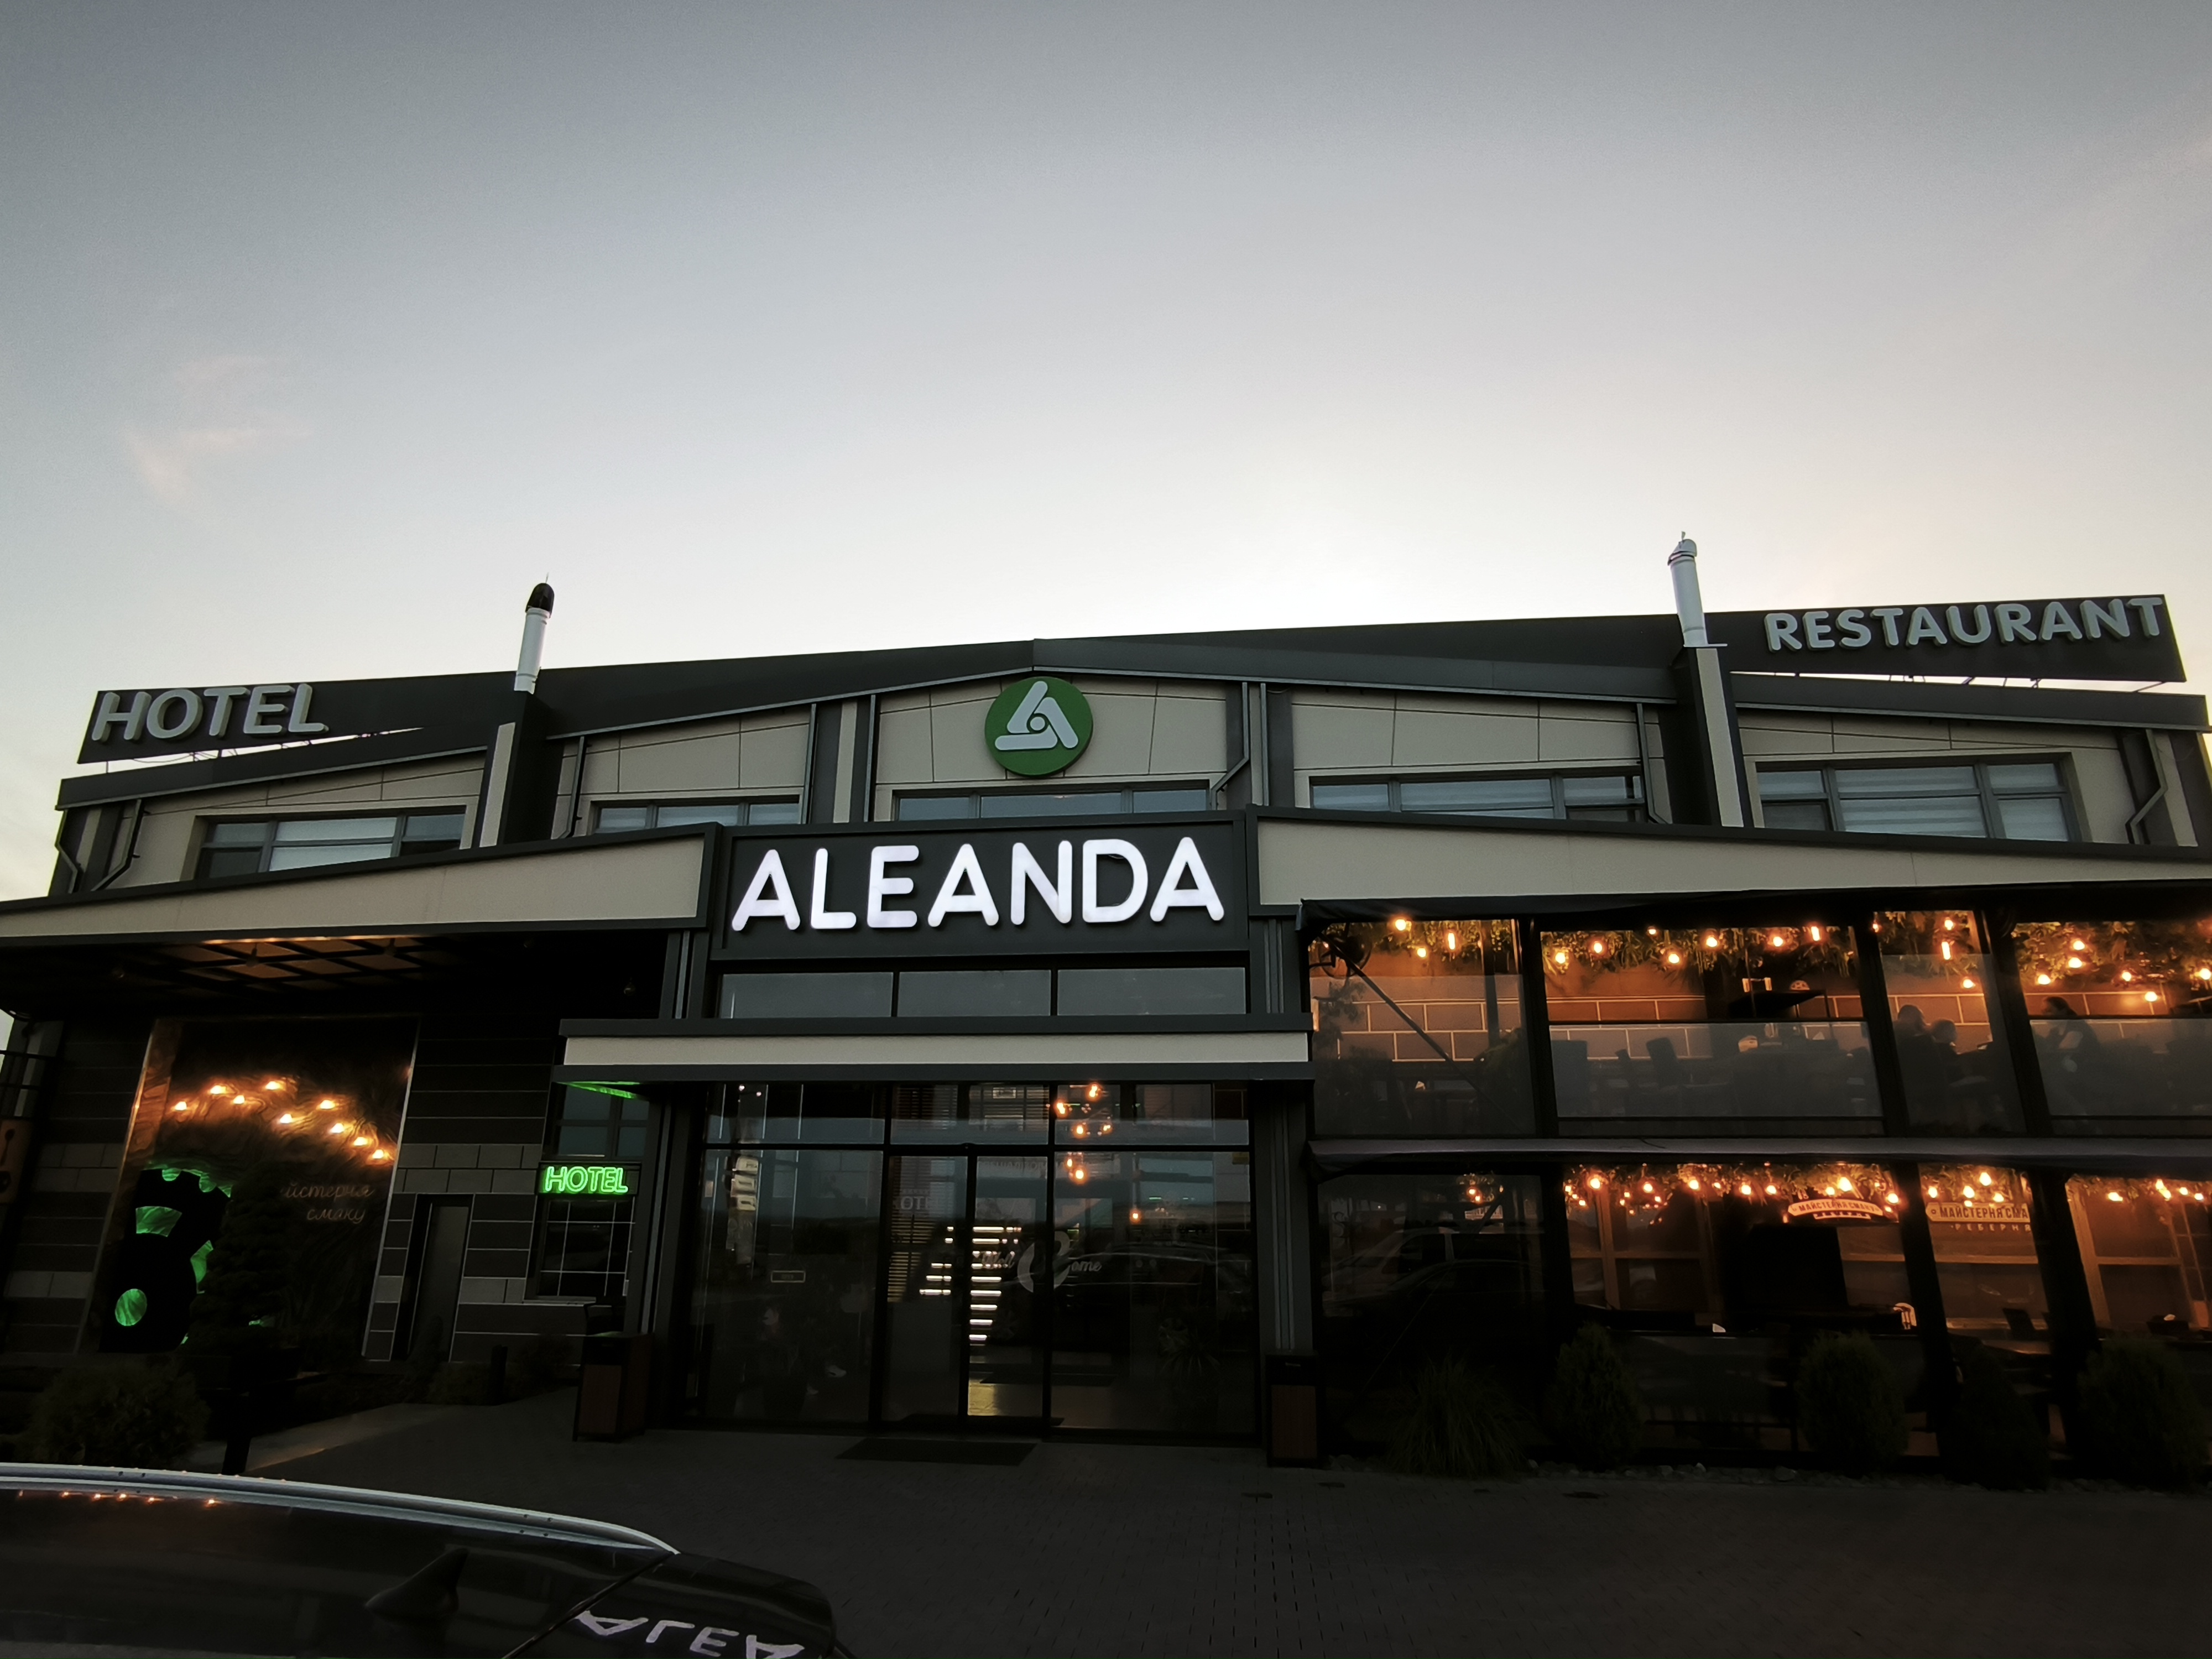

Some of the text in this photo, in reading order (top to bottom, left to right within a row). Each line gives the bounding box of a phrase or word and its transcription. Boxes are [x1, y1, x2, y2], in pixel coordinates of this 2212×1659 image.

[1764, 597, 2163, 653] RESTAURANT
[91, 683, 329, 743] HOTEL
[732, 836, 1225, 932] ALEANDA
[280, 1181, 377, 1203] йстерня
[545, 1166, 629, 1193] HOTEL
[307, 1208, 366, 1224] смаку
[1939, 1205, 2029, 1218] МАЙСТЕРНЯ СМА
